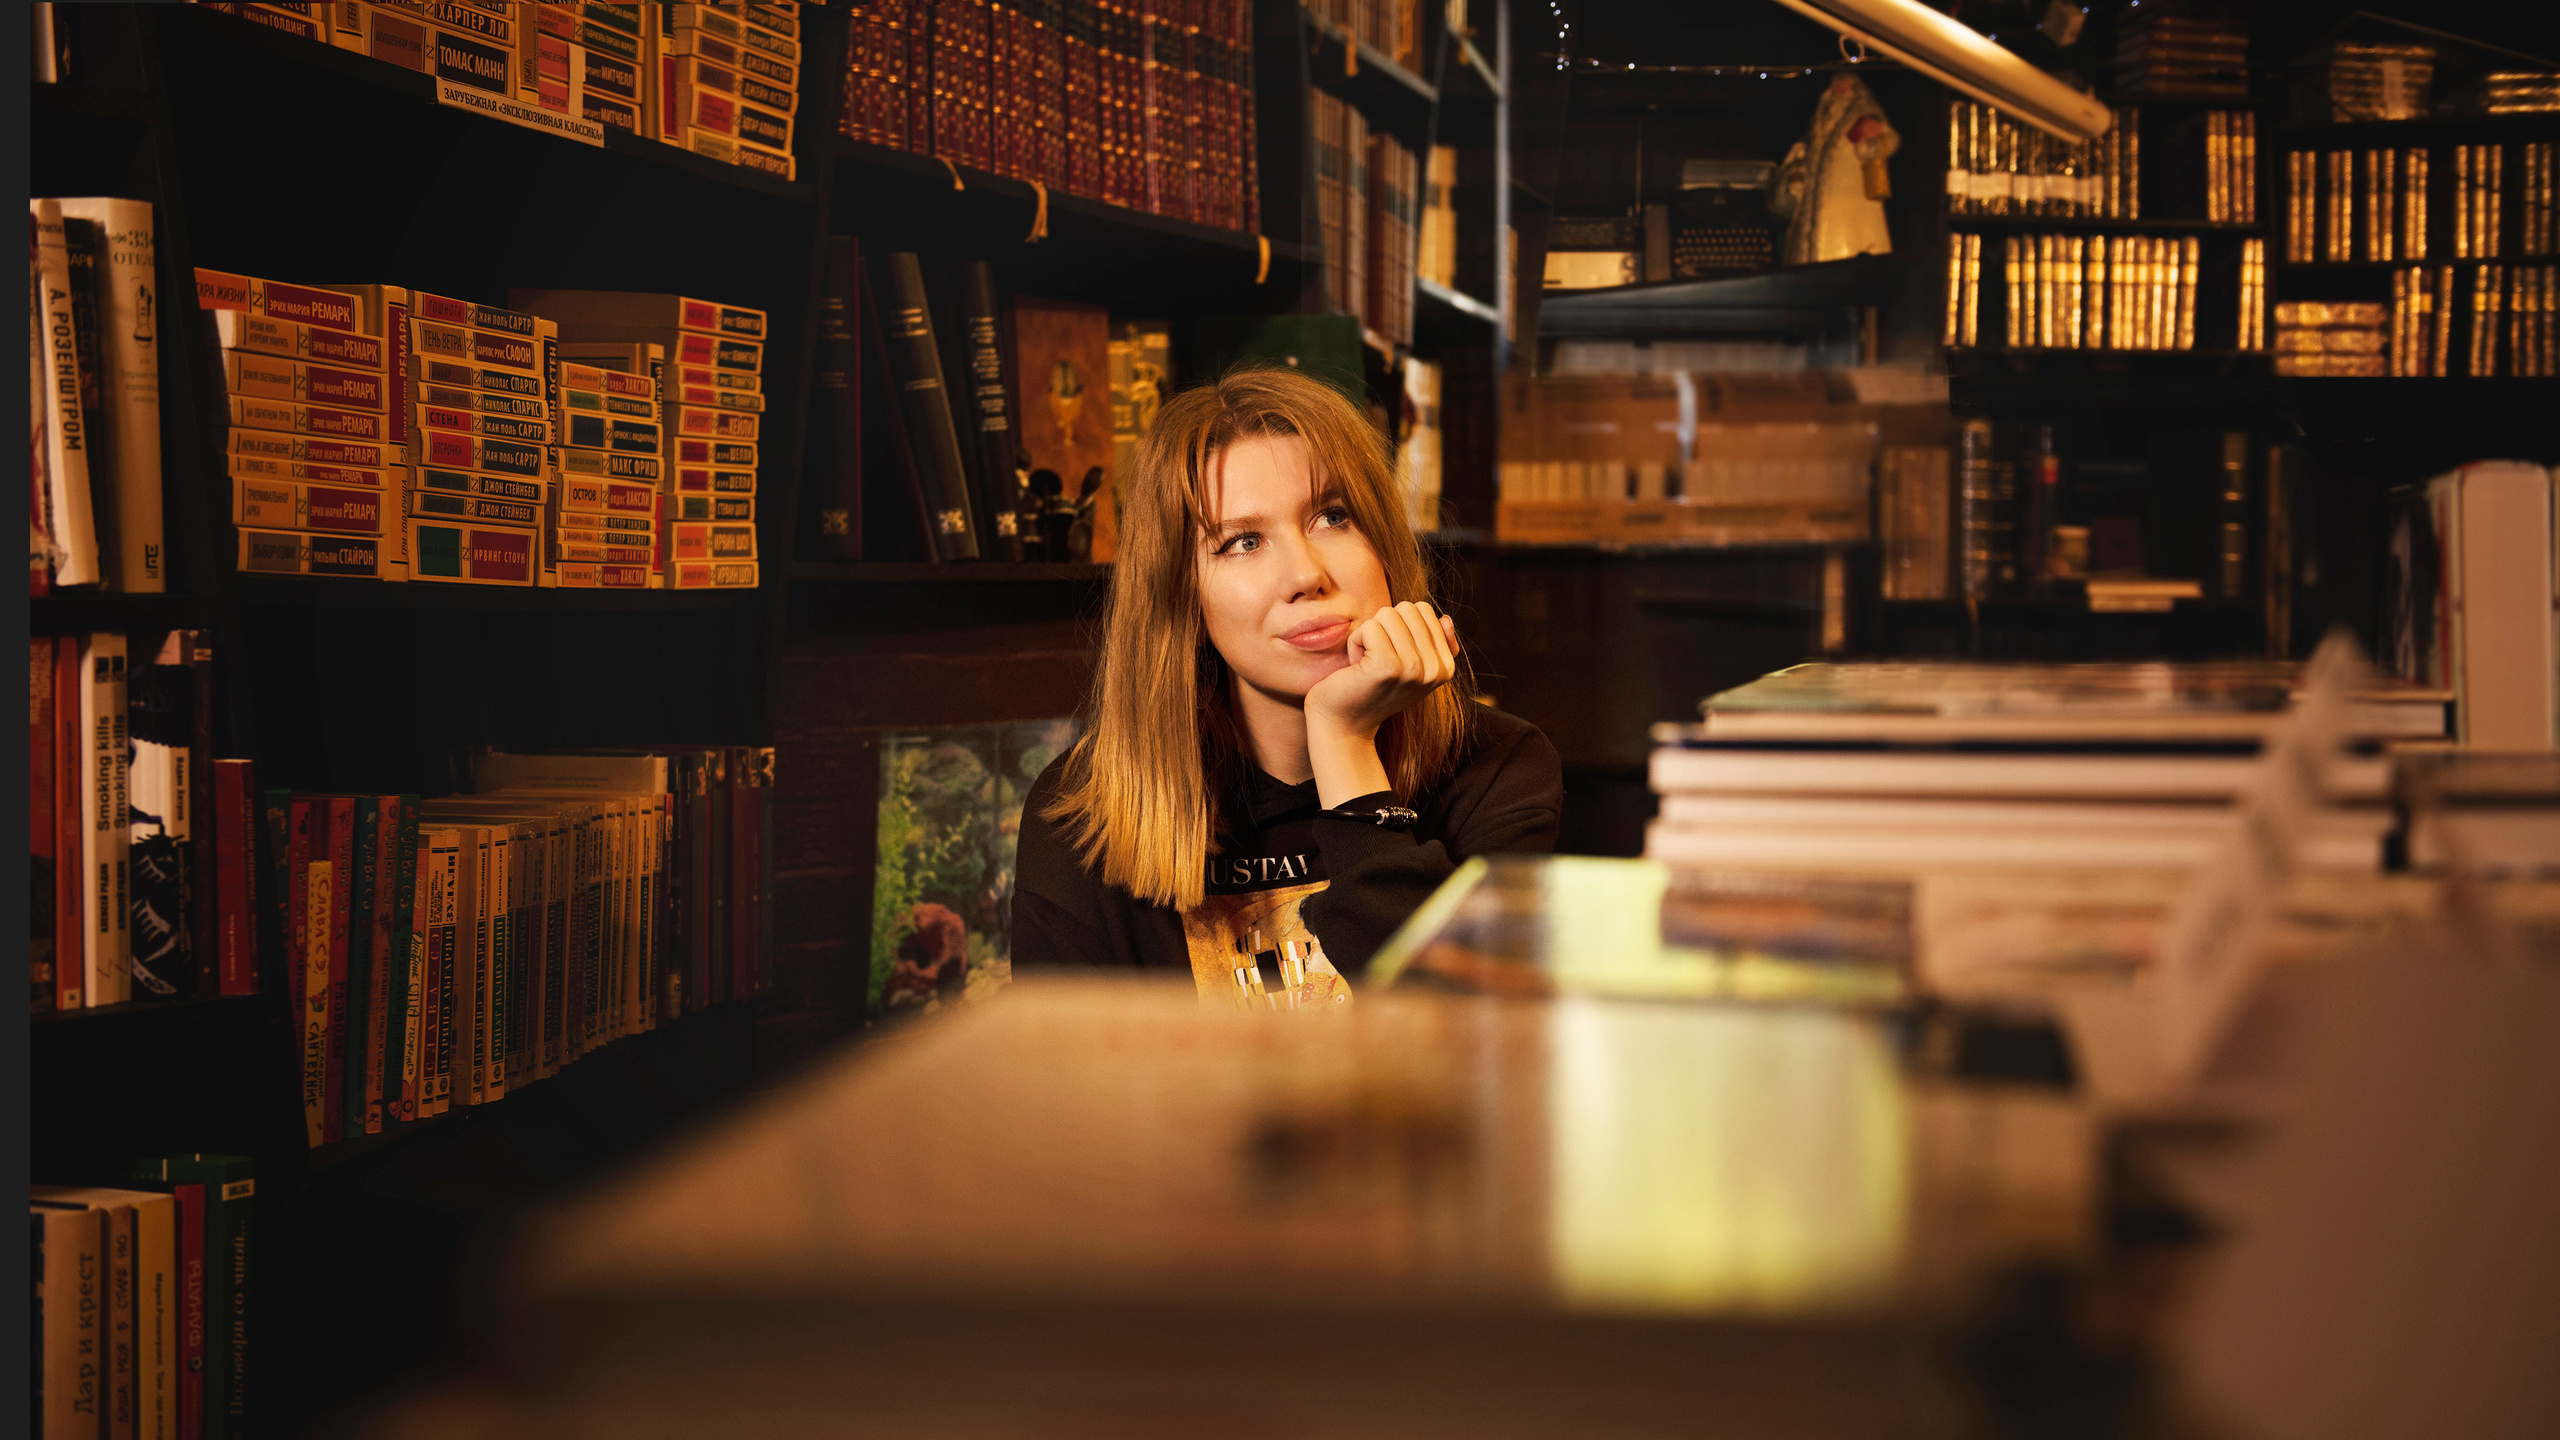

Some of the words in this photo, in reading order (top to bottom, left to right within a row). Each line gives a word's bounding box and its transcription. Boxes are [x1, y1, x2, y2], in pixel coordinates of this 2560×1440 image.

[269, 14, 307, 37] ГОЛДИНГ
[438, 3, 486, 32] ХАРПЕР
[488, 18, 506, 39] ЛИ
[439, 45, 474, 73] ТОМАС
[474, 55, 505, 82] МАНН
[524, 58, 533, 85] УБИТЬ
[600, 65, 634, 88] МИТЧЕЛЛ
[444, 88, 497, 113] ЗАРУБЕЖНАЯ
[600, 107, 633, 129] МИТЧЕЛЛ
[49, 288, 67, 306] А.
[215, 284, 246, 304] ЖИЗНИ
[269, 300, 286, 313] ЭРИХ
[286, 303, 311, 317] МАРИЯ
[311, 301, 351, 324] РЕМАРК
[427, 299, 462, 318] ТОШНОТА
[478, 311, 492, 324] ЖАН
[492, 314, 508, 328] ПОЛЬ
[508, 314, 533, 333] САРТР
[312, 340, 326, 352] ЭРИХ
[326, 343, 343, 356] МАРИЯ
[343, 339, 378, 364] РЕМАРК
[399, 310, 408, 377] РЕМАРК
[424, 329, 441, 348] ТЕНЬ
[441, 332, 463, 352] ВЕТРА
[505, 343, 533, 364] САФОН
[52, 312, 82, 451] РОЗЕНШТРОМ
[484, 375, 509, 390] НИКОЛАС
[510, 375, 538, 395] СПАРКС
[549, 346, 557, 394] ОСТЕН
[625, 376, 650, 396] ХАКСЛИ
[312, 381, 325, 393] ЭРИХ
[325, 384, 343, 396] МАРИЯ
[343, 379, 376, 400] РЕМАРК
[429, 411, 459, 427] СТЕНА
[485, 421, 500, 434] ЖАН
[500, 423, 516, 435] ПОЛЬ
[518, 422, 543, 439] САРТР
[484, 400, 511, 413] НИКОЛАС
[511, 399, 540, 418] СПАРКС
[312, 418, 326, 430] ЭРИХ
[325, 420, 342, 432] МАРИЯ
[342, 415, 374, 436] РЕМАРК
[308, 446, 325, 459] ЭРИХ
[324, 449, 344, 461] МАРИЯ
[344, 446, 378, 465] РЕМАРК
[432, 441, 462, 457] ОТСРОЧКА
[484, 449, 499, 462] ЖАН
[499, 451, 515, 464] ПОЛЬ
[514, 451, 538, 468] САРТР
[612, 456, 633, 474] МАКС
[633, 459, 657, 477] ФРИШ
[340, 469, 364, 485] РЕМАРК
[484, 479, 504, 495] ДЖОН
[505, 480, 536, 499] СТЕЙНБЕК
[311, 505, 325, 517] ЭРИХ
[325, 506, 343, 519] МАРИЯ
[343, 502, 377, 521] РЕМАРК
[401, 479, 409, 536] ТОВАРИЩА
[479, 502, 499, 517] ДЖОН
[500, 503, 531, 521] СТЕЙНБЕК
[572, 488, 597, 502] ОСТРОВ
[626, 490, 650, 508] ХАКСЛИ
[313, 550, 338, 565] УИЛЬЯМ
[338, 546, 375, 567] СТАЙРОН
[400, 539, 408, 557] ТРИ
[473, 547, 502, 563] ИРВИНГ
[504, 550, 526, 565] СТОУН
[625, 549, 649, 562] ХАКСЛИ
[620, 568, 645, 585] ХАКСЛИ
[97, 715, 111, 751] kills
[113, 714, 126, 749] kills
[97, 756, 113, 832] Smoking
[114, 754, 129, 829] Smoking
[446, 855, 456, 922] ЗУЛАЛИ
[99, 894, 109, 933] АЛЕКСЕЙ
[117, 891, 126, 930] АЛЕКСЕЙ
[315, 878, 330, 938] СЛАВА
[315, 943, 328, 971] СЭ
[430, 932, 441, 960] СЭ
[475, 925, 486, 992] АБГАРЯН
[442, 930, 454, 999] АБГАРЯН
[495, 921, 504, 1005] ВАЛИУЛЛИН
[333, 980, 346, 1059] РАЗВОДЫ
[426, 986, 439, 1071] СЛАВА
[474, 1000, 484, 1062] НАРИНЭ
[494, 1011, 503, 1057] РИНАТ
[440, 1005, 451, 1069] НАРИНЭ
[304, 1021, 320, 1108] САНТЕХНИК
[77, 1252, 97, 1331] крест
[116, 1266, 129, 1310] СТИЛЕ
[155, 1272, 164, 1306] Мария
[187, 1258, 203, 1348] ФАНАТЫ
[233, 1293, 246, 1315] со
[117, 1321, 128, 1333] В
[80, 1338, 92, 1355] и
[116, 1341, 129, 1374] МОЯ
[228, 1320, 249, 1416] Поговори
[74, 1363, 96, 1414] Дар
